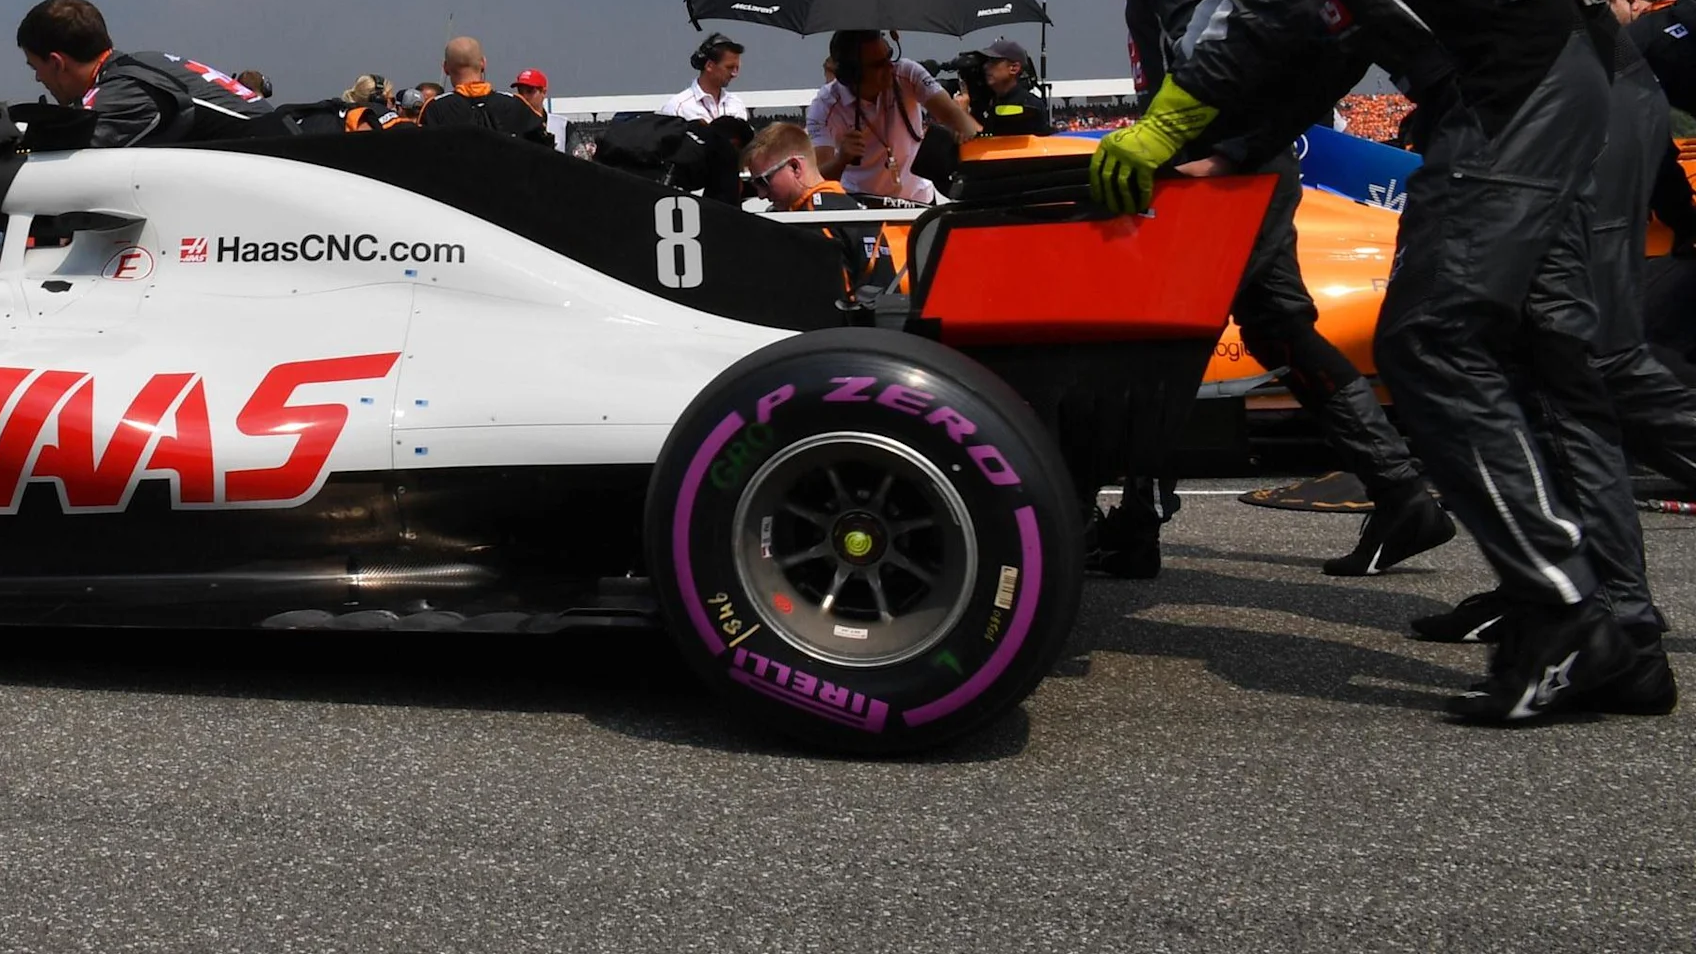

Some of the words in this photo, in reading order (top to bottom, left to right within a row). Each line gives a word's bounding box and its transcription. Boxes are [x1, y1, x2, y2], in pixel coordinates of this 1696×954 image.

[216, 233, 466, 263] HaasCNC.com
[654, 196, 704, 289] 8
[757, 383, 795, 424] P
[822, 376, 1022, 486] ZERO
[729, 646, 890, 735] PIRELLI
